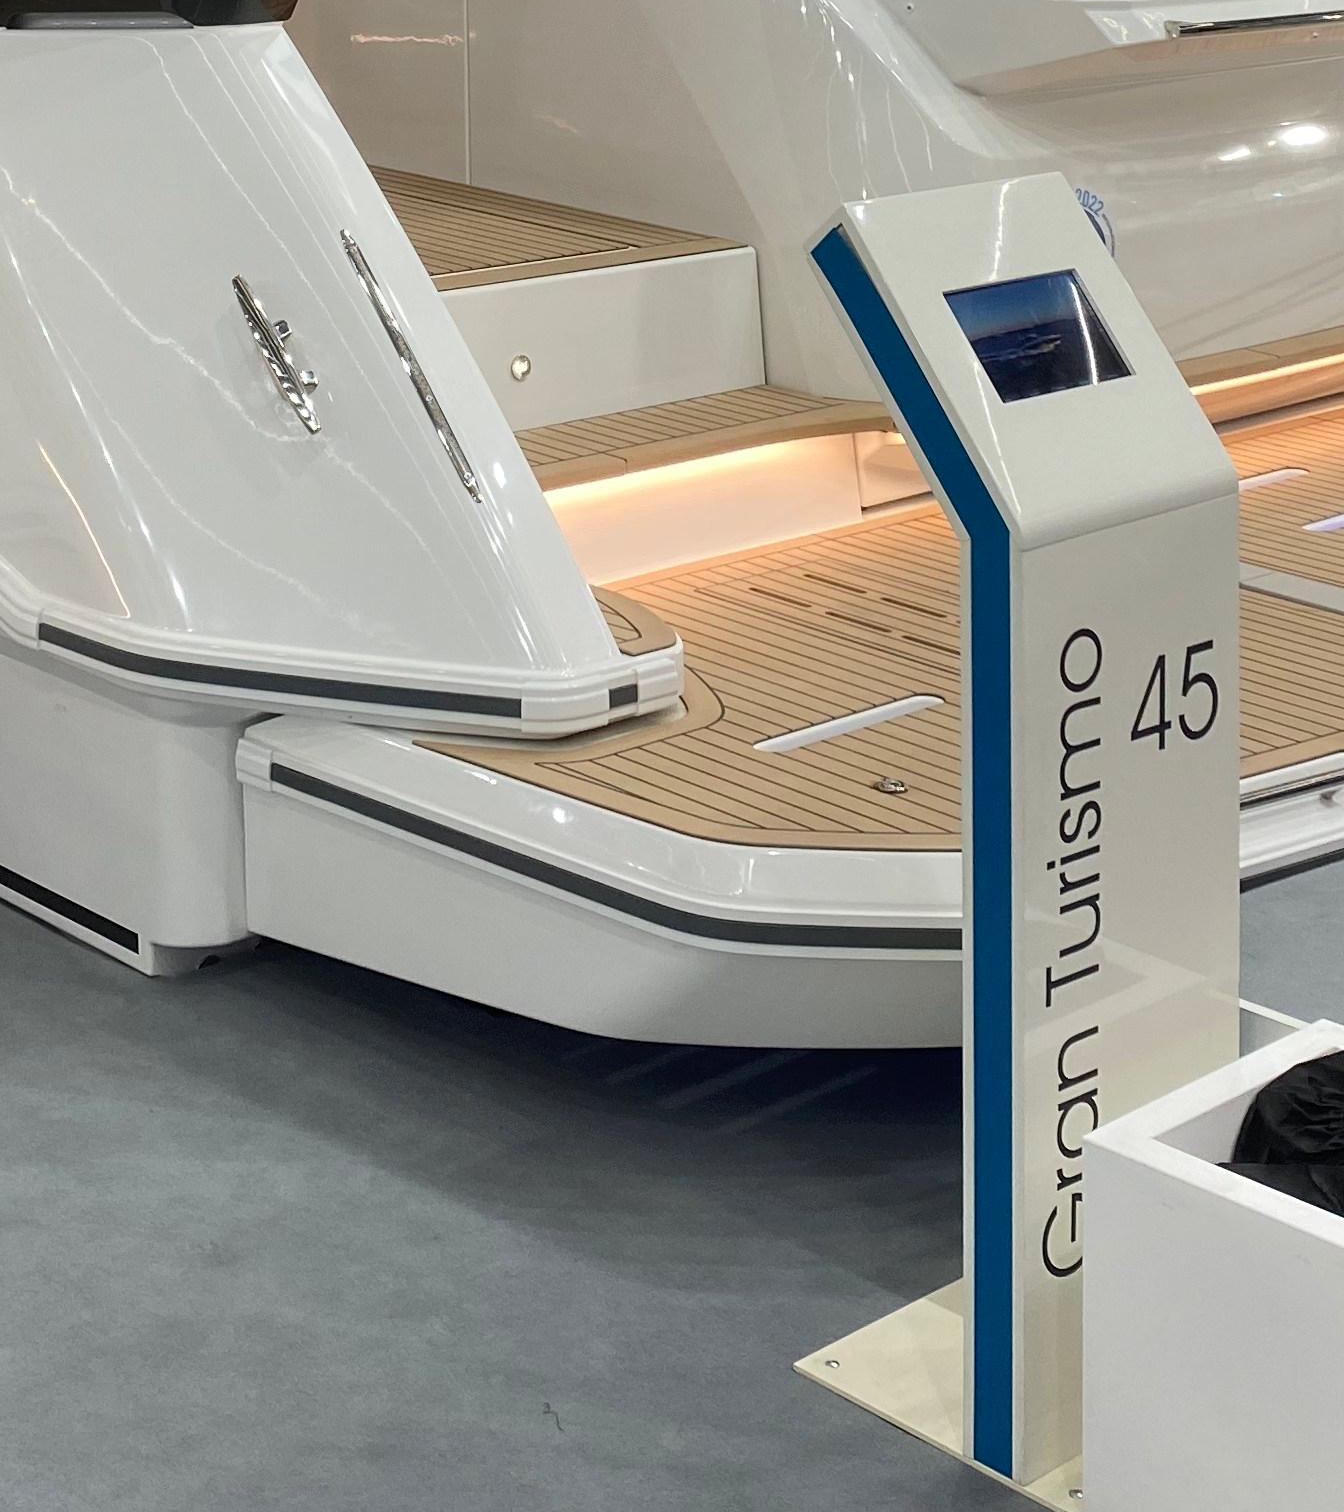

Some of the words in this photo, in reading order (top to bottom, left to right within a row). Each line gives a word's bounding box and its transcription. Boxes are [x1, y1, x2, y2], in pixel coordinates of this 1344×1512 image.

[1045, 627, 1103, 1008] Turismo
[1130, 639, 1219, 751] 45
[1041, 1025, 1099, 1279] Gran
